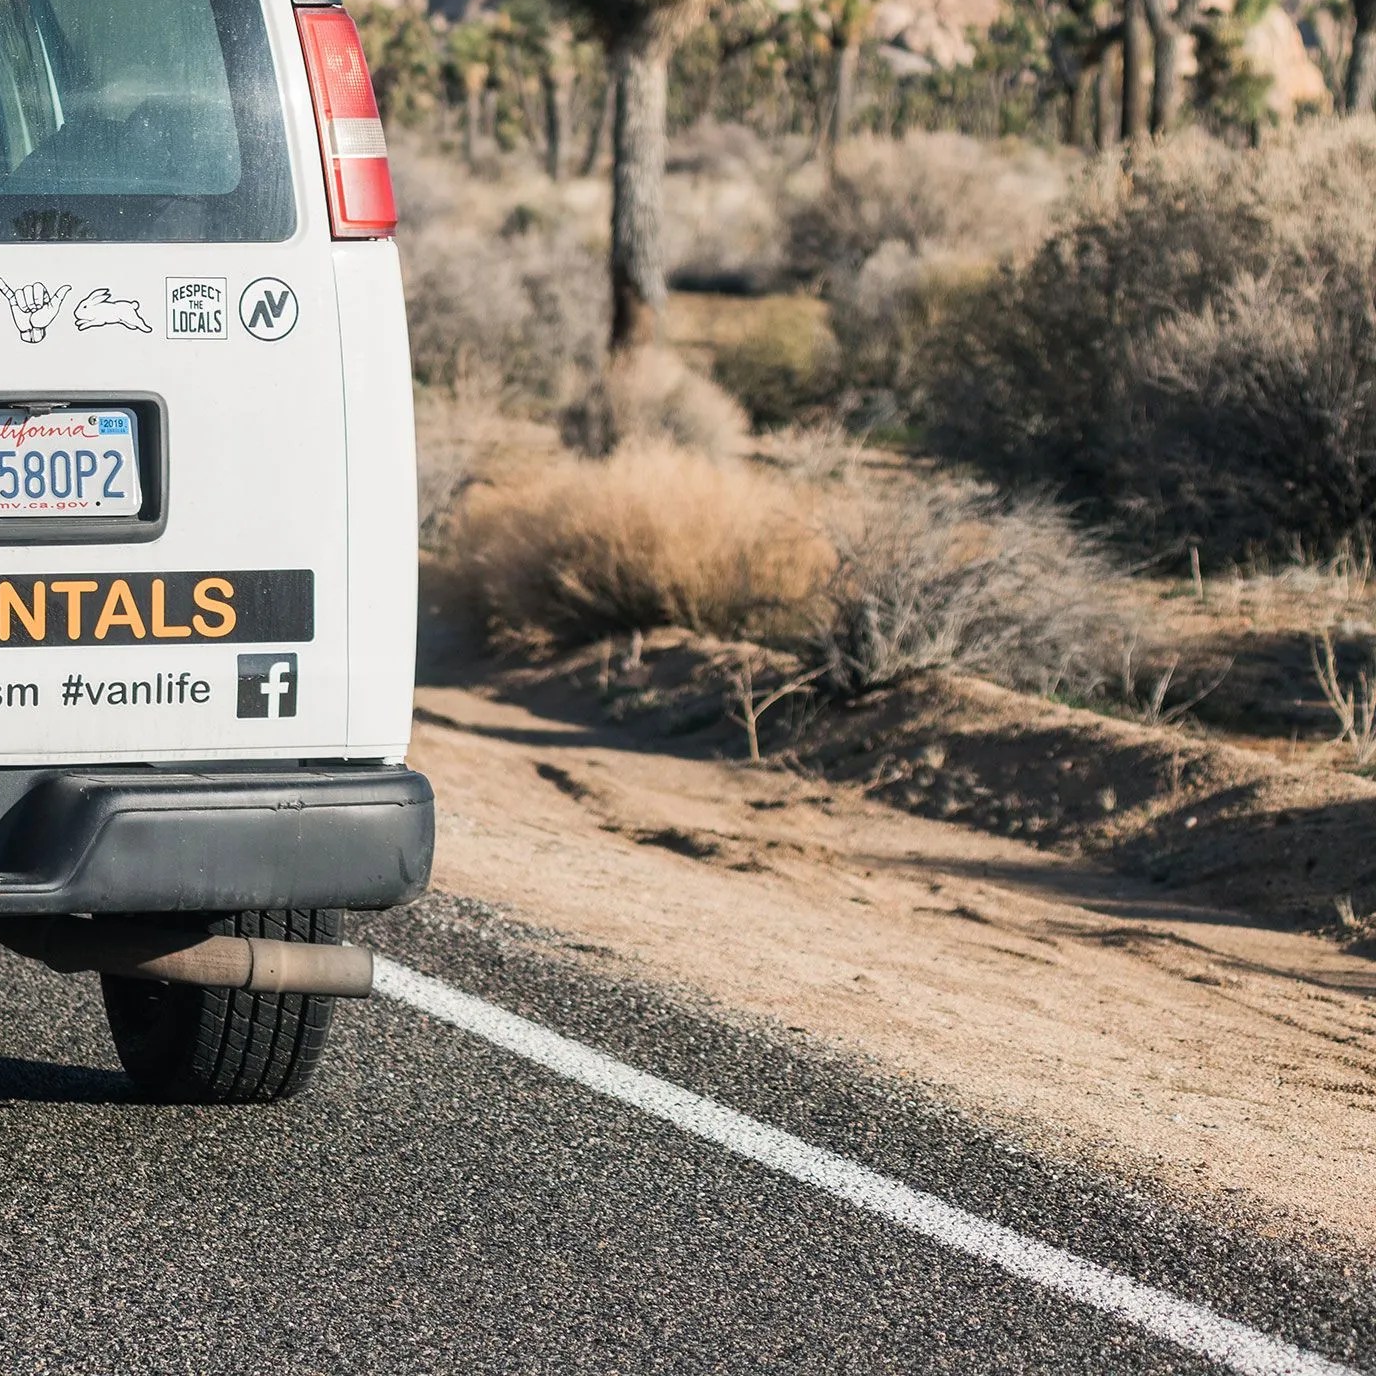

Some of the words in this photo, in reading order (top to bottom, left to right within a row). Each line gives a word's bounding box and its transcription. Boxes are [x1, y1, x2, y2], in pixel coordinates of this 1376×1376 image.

[171, 283, 223, 304] RESPECT
[188, 299, 204, 310] THE
[171, 308, 223, 334] LOCALS
[103, 418, 124, 428] 2019
[61, 672, 212, 707] #vanlife
